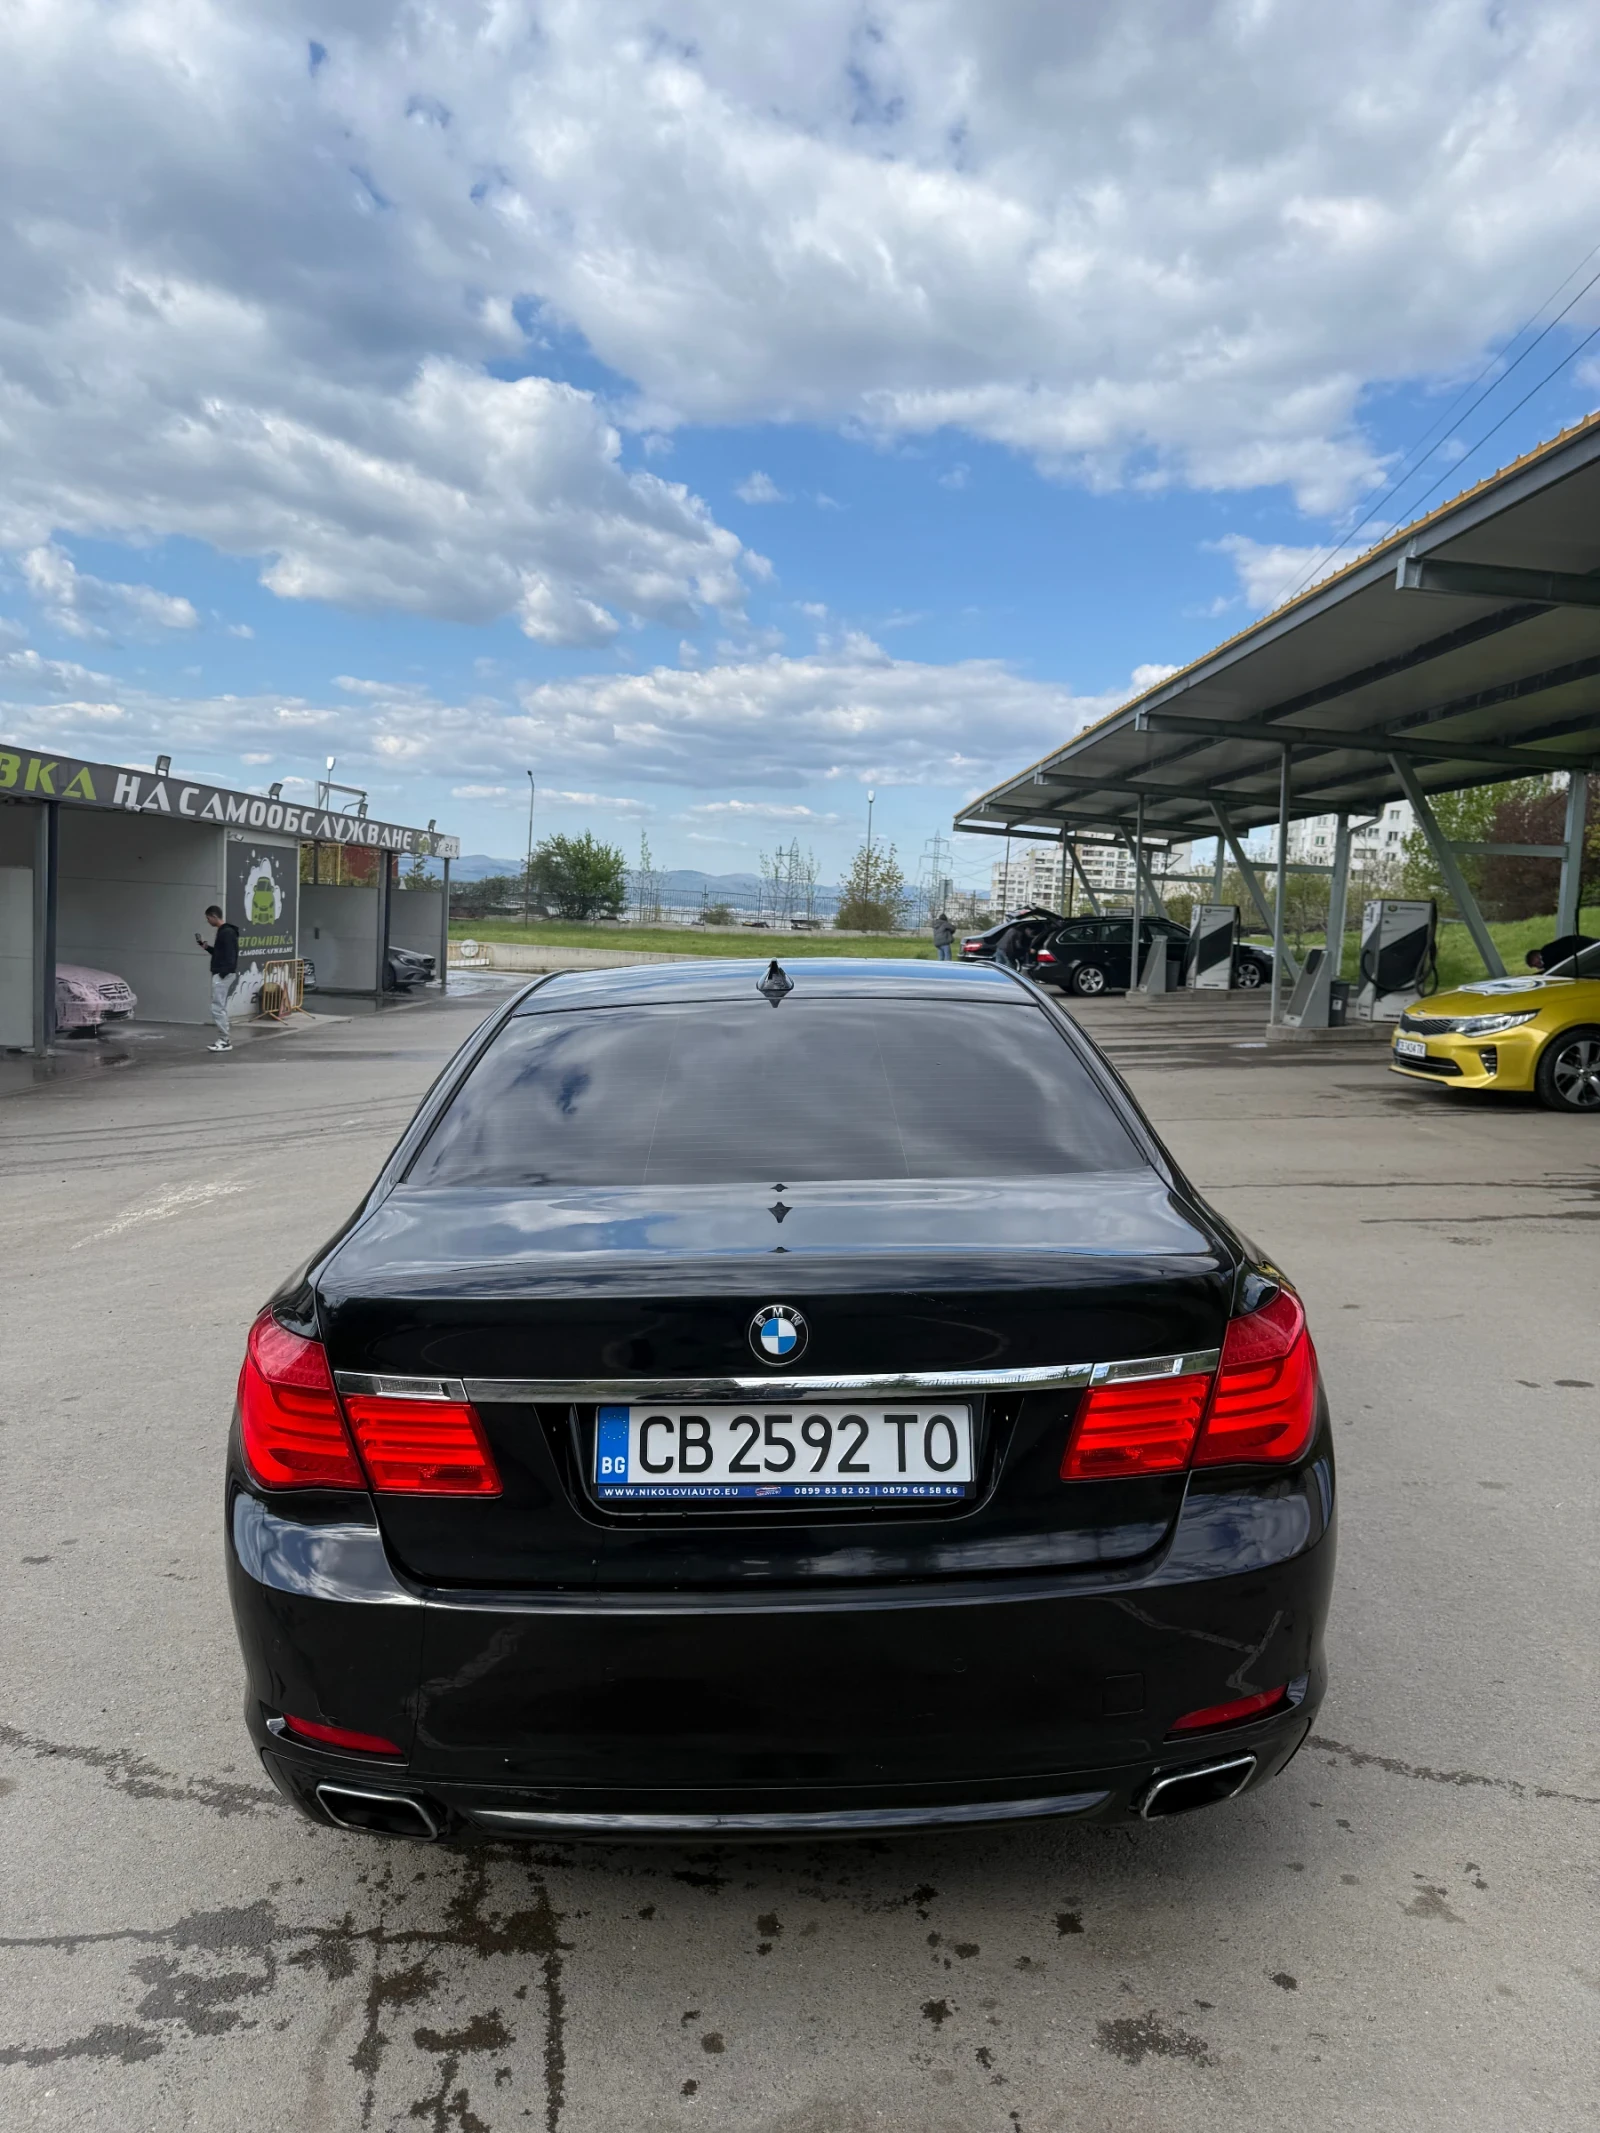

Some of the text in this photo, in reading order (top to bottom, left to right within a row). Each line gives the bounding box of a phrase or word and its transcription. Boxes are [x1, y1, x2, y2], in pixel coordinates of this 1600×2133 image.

[113, 773, 171, 812] НА
[179, 787, 412, 850] САМООБСЛУЖВАНЕ
[238, 935, 293, 948] ВТОМИВКА
[755, 1307, 804, 1327] BMW
[639, 1414, 958, 1474] CB 2592 TO
[601, 1456, 626, 1474] BG
[604, 1488, 739, 1496] WWW.NIKOLOVIAUTO.EU
[794, 1486, 820, 1495] 0899
[824, 1486, 837, 1495] 83
[841, 1486, 854, 1495] 82
[858, 1486, 871, 1494] 02
[882, 1486, 908, 1494] 0879
[912, 1486, 925, 1494] 66
[929, 1486, 942, 1494] 58
[945, 1486, 958, 1494] 66
